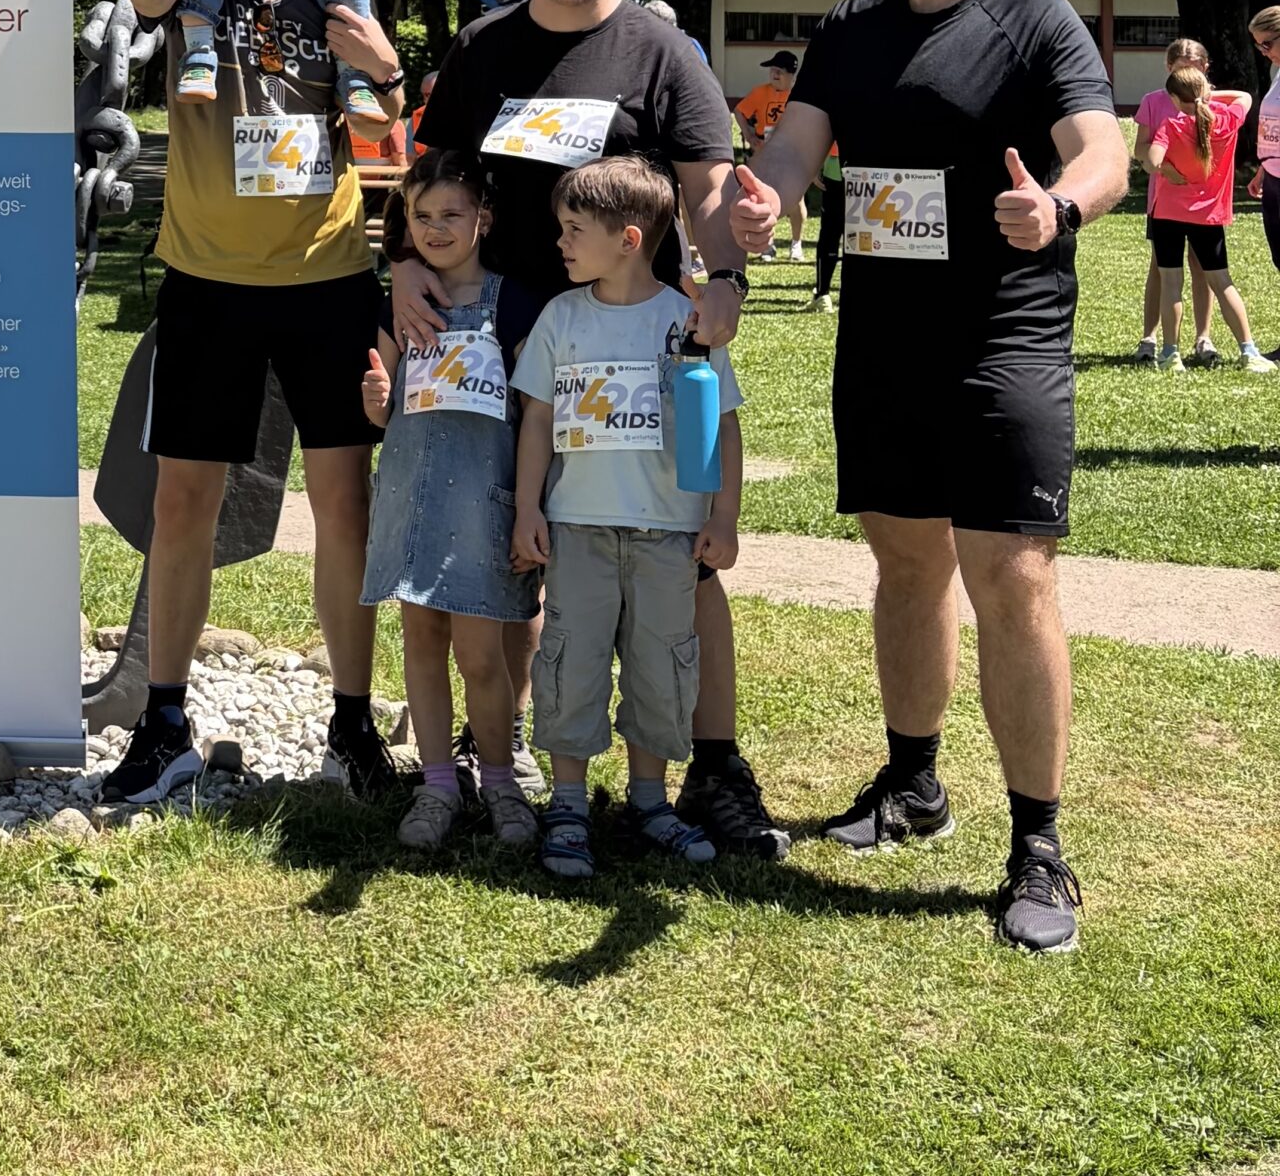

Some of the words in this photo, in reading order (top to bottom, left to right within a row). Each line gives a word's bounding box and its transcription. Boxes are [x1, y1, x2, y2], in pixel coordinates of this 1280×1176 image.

[235, 129, 278, 144] RUN
[267, 130, 303, 169] 4
[296, 160, 332, 176] KIDS
[499, 107, 545, 117] RUN
[523, 108, 564, 136] 4
[548, 132, 603, 153] KIDS
[871, 172, 882, 180] JCI
[846, 181, 875, 198] RUN
[866, 185, 900, 229] 4
[892, 221, 945, 239] KIDS
[442, 335, 455, 343] JCI
[407, 344, 447, 361] RUN
[431, 344, 468, 384] 4
[455, 376, 505, 401] KIDS
[581, 367, 593, 375] JCI
[554, 377, 586, 397] RUN
[577, 378, 614, 422] 4
[605, 412, 660, 429] KIDS
